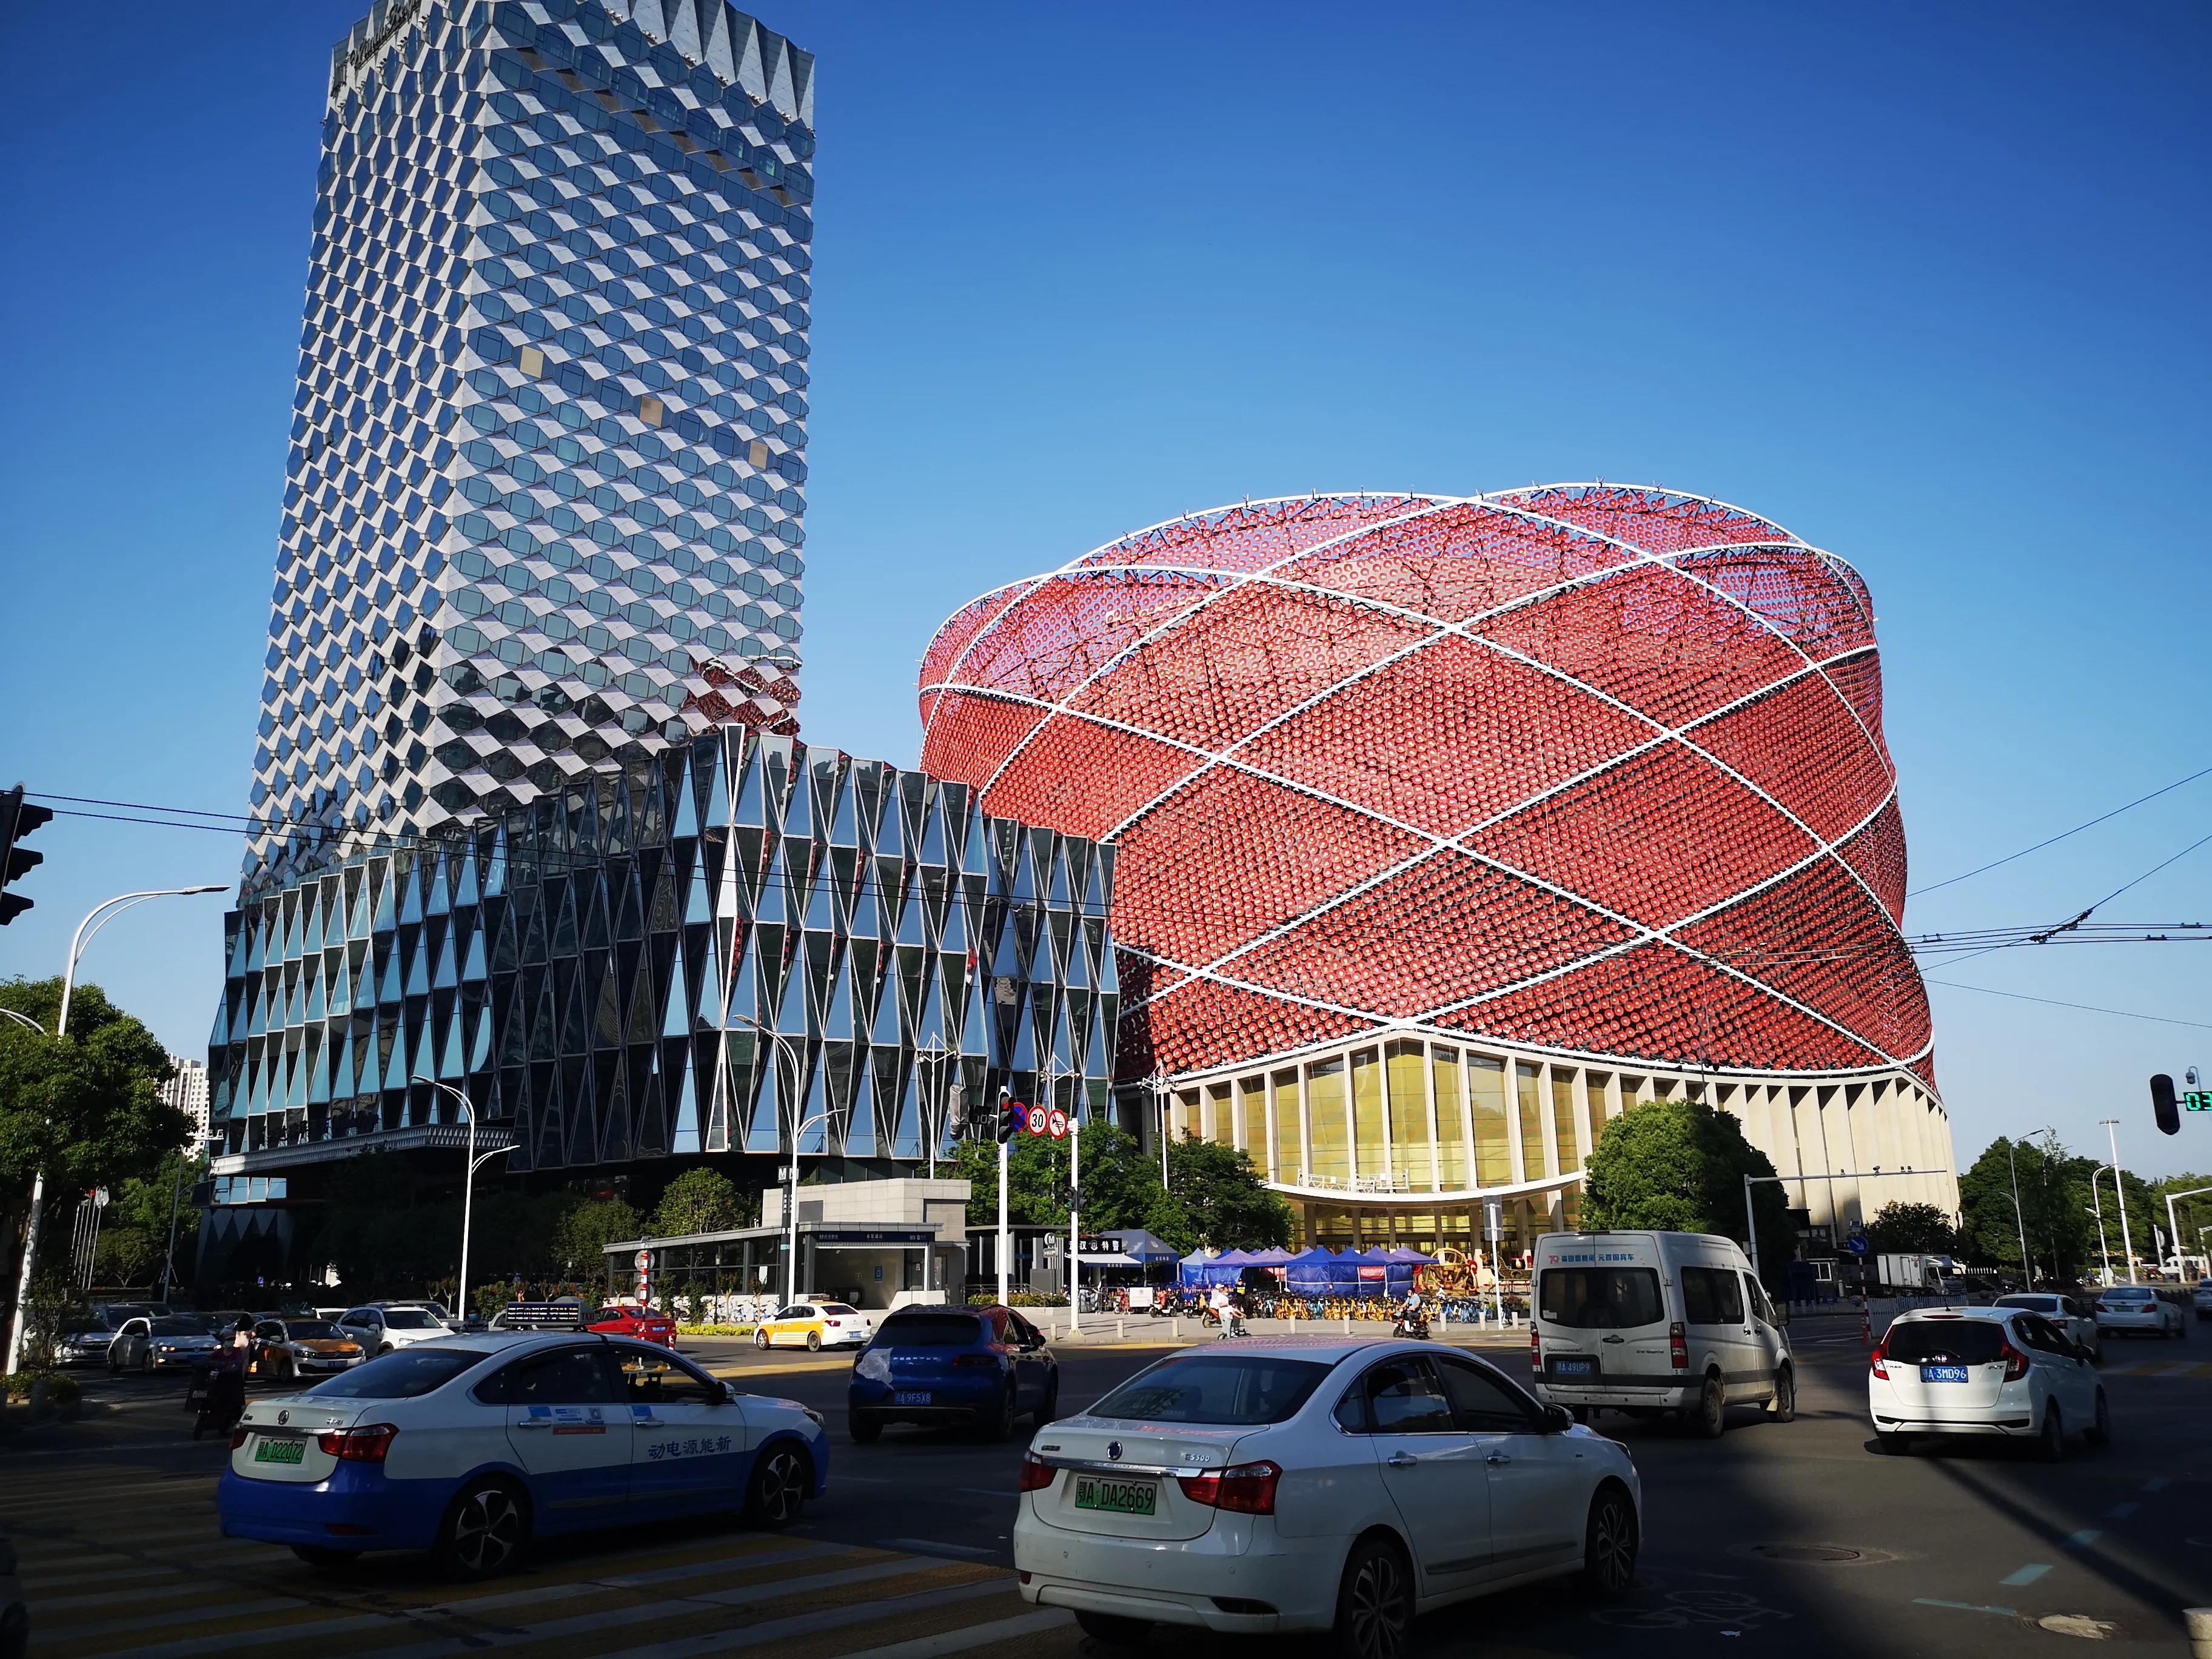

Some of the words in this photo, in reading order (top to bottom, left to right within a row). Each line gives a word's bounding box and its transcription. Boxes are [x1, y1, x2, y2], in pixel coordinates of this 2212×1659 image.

[2186, 1092, 2212, 1110] 03
[1031, 1113, 1044, 1128] 30
[779, 1167, 786, 1181] M
